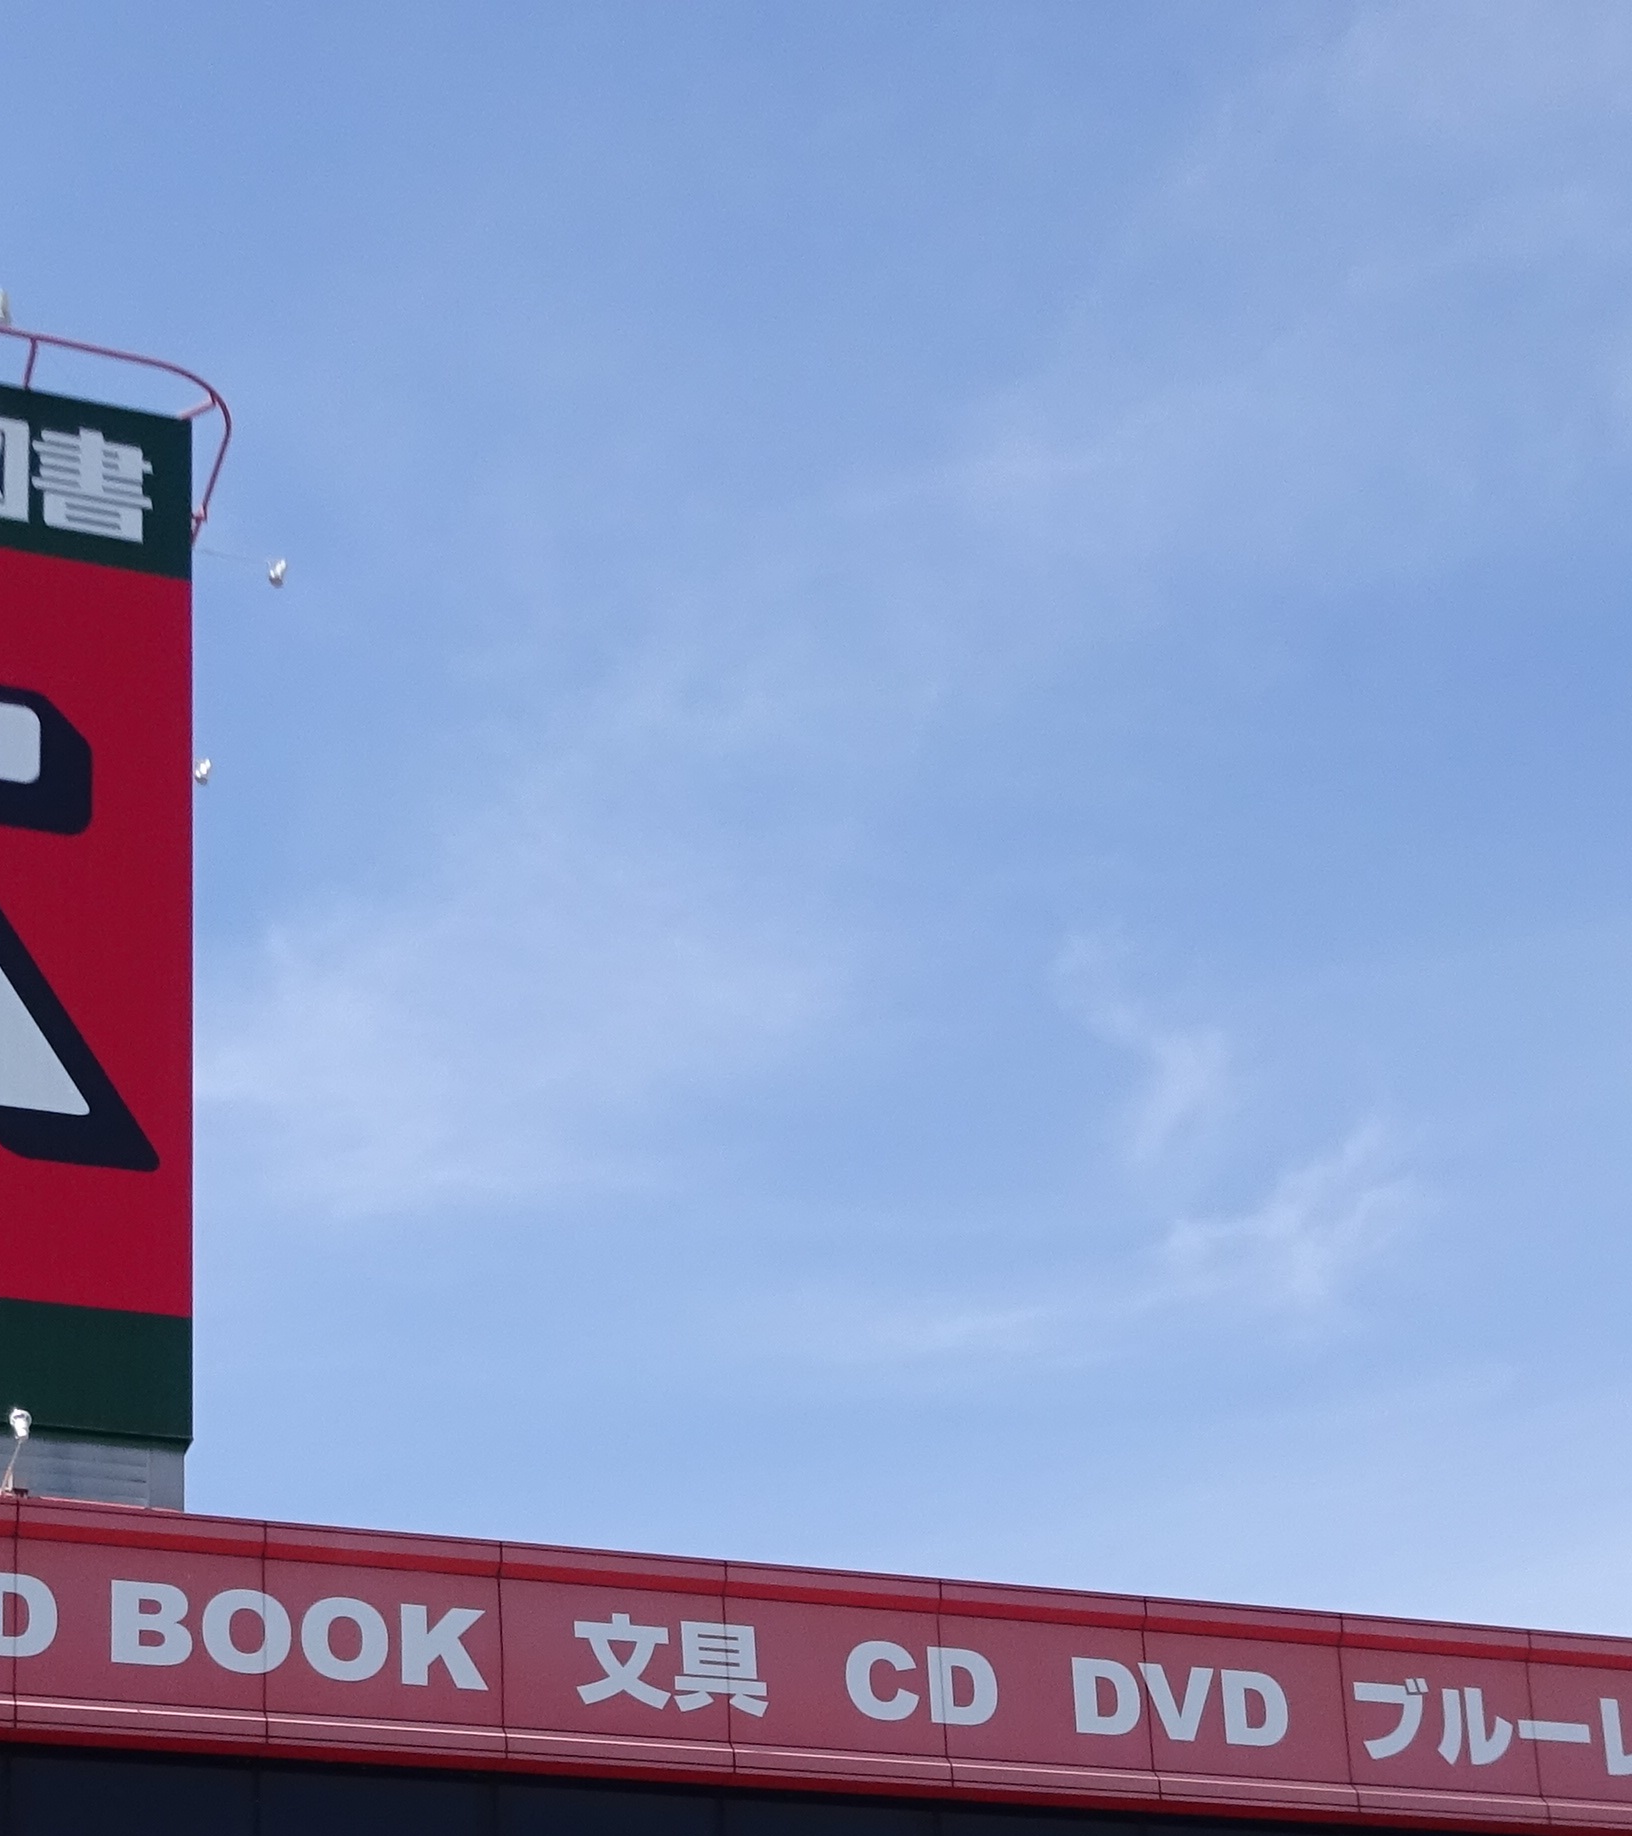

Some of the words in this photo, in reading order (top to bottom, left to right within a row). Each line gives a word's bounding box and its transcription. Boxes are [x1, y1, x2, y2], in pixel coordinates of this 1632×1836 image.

[109, 1578, 489, 1693] BOOK
[572, 1612, 770, 1717] 文具
[844, 1640, 1000, 1727] CD
[1072, 1656, 1291, 1748] DVD
